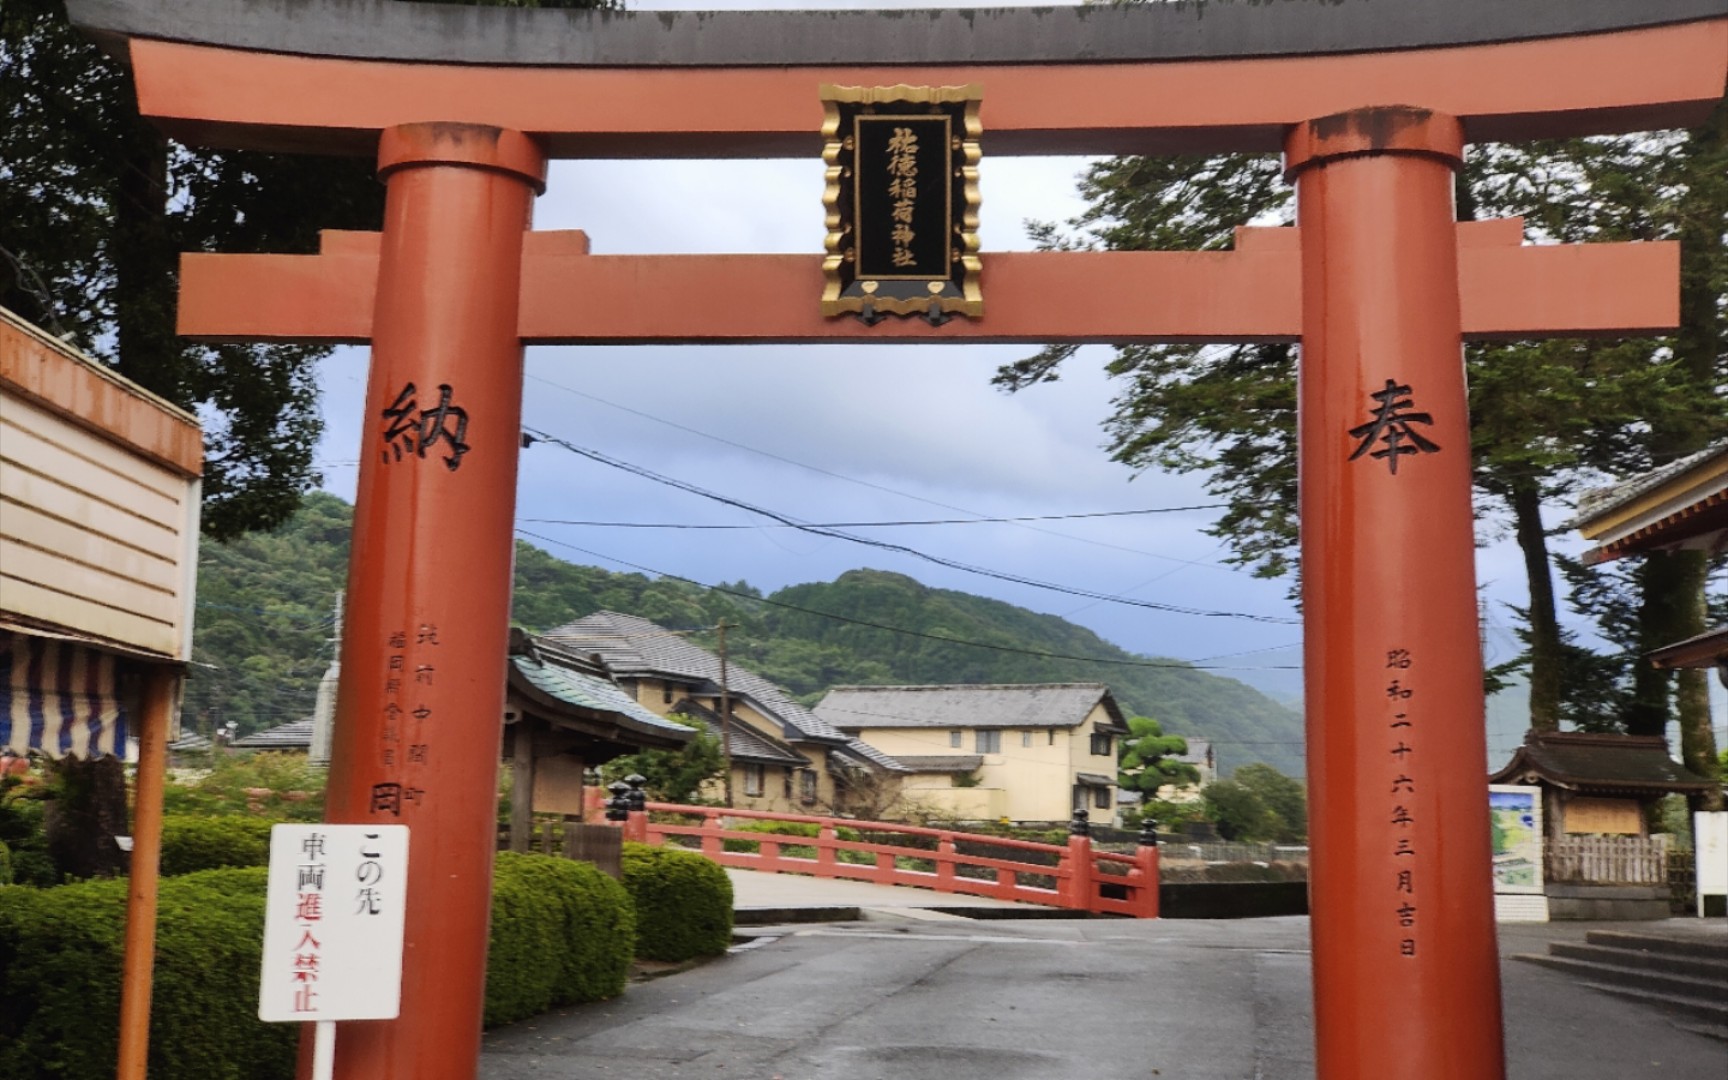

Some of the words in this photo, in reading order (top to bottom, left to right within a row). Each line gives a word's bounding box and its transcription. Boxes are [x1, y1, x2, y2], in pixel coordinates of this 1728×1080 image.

[885, 127, 920, 267] 祐徳稲荷神社
[382, 382, 471, 472] 納
[1347, 379, 1441, 475] 奉
[1386, 648, 1417, 957] 昭和二十六年三月吉日
[291, 832, 327, 1014] 車両進入禁止
[354, 832, 384, 916] この先
